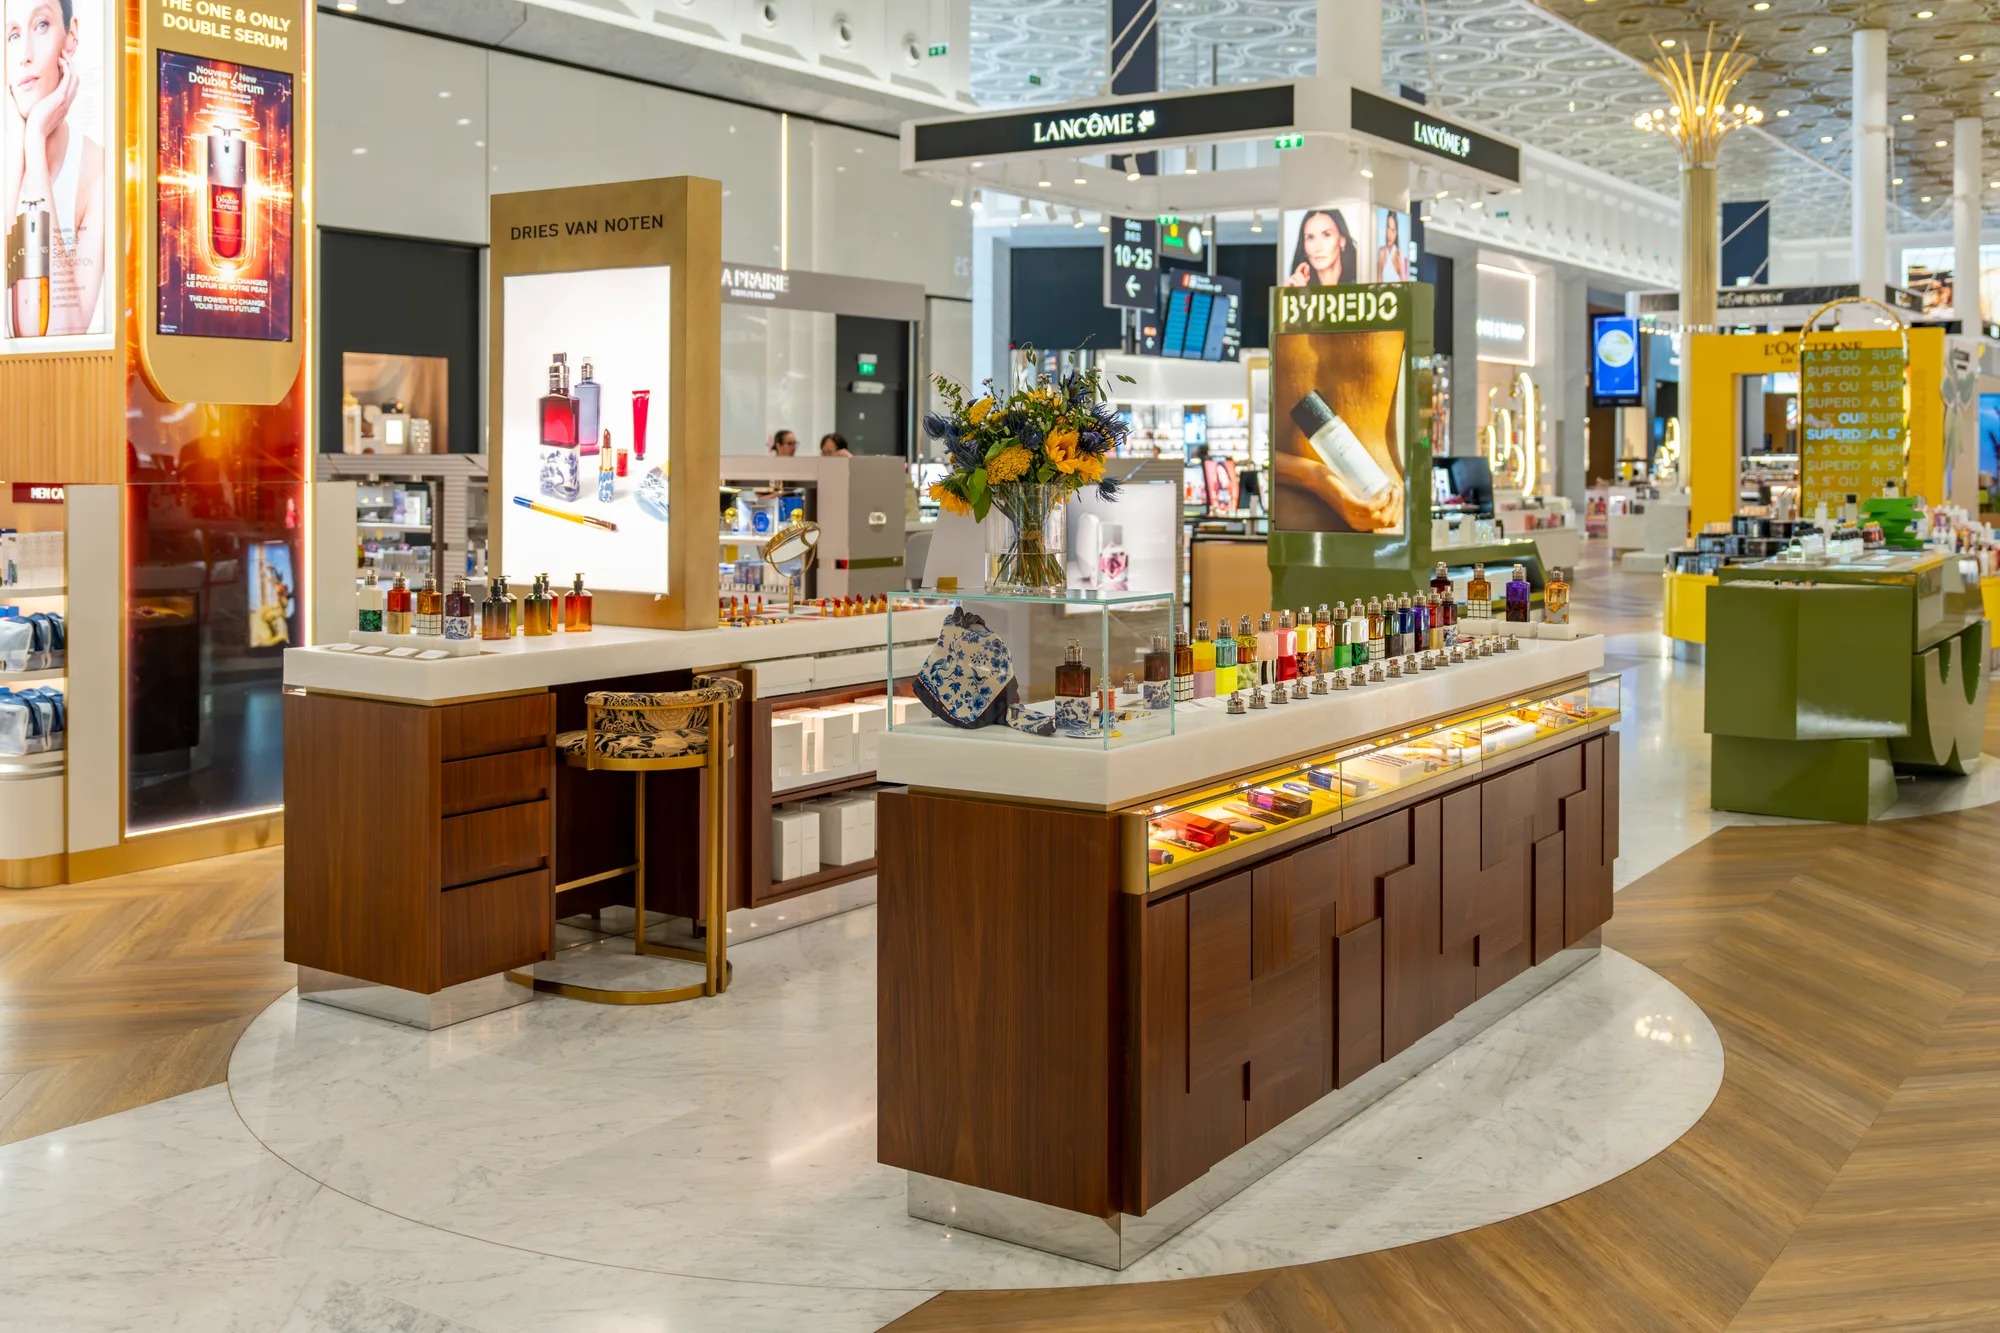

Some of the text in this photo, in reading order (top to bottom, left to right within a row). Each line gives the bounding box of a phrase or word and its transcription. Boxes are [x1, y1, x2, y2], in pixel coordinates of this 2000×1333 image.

[196, 1, 232, 20] ONE
[235, 9, 246, 23] &
[249, 12, 291, 32] ONLY
[163, 12, 288, 51] DOUBLE SERUM
[188, 71, 264, 95] Double Serum
[196, 65, 232, 79] Nouveau
[239, 73, 257, 84] New
[1033, 112, 1134, 143] LANCÔME
[1414, 121, 1461, 156] LANCÔME
[511, 214, 663, 240] DRIES VAN NOTEN
[196, 274, 225, 283] POUVO
[237, 277, 268, 287] CHANGER
[196, 282, 217, 290] FUTUR
[734, 269, 789, 292] PRAIRIE
[203, 296, 227, 304] POWER
[239, 299, 265, 307] CHANGE
[1281, 291, 1398, 324] BYREDO
[1838, 412, 1868, 424] OUR
[31, 487, 50, 499] MEN
